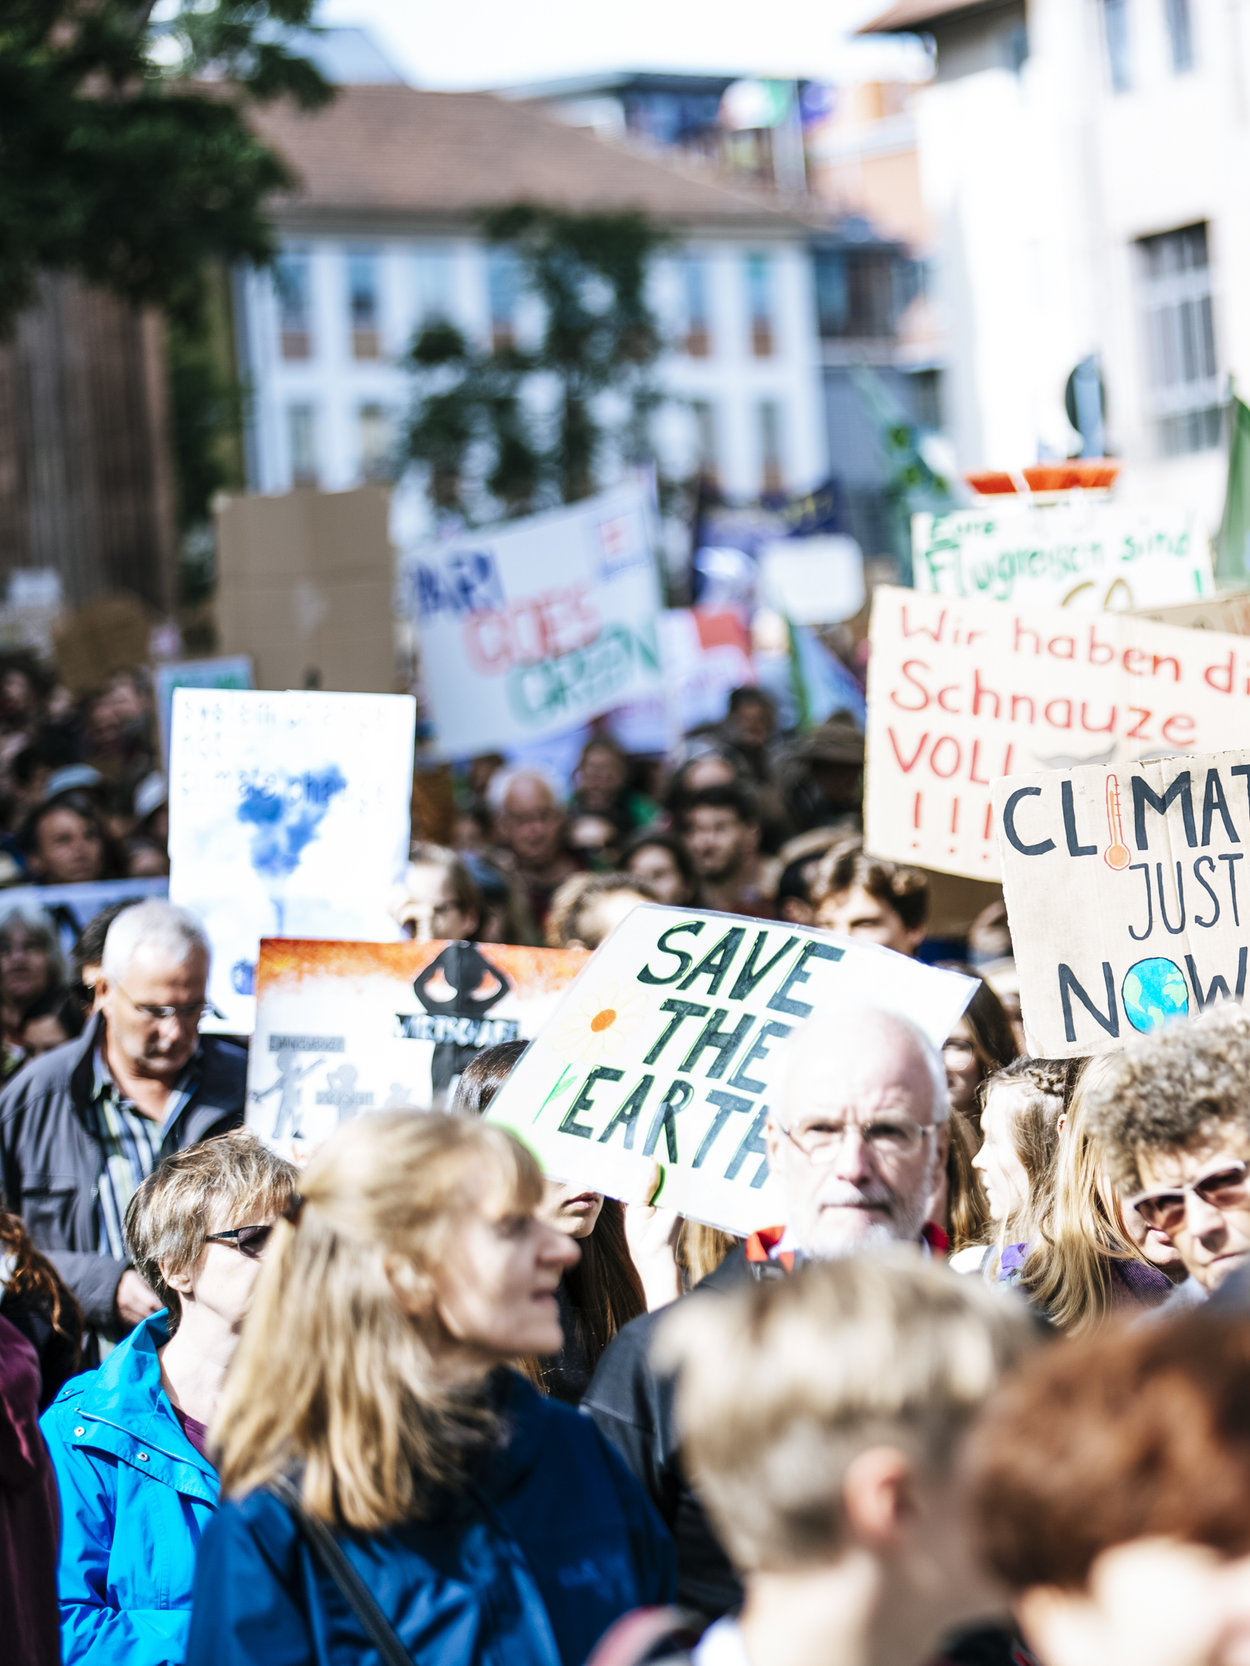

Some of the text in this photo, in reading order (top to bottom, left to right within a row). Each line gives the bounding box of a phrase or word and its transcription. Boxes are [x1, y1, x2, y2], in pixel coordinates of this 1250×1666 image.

[901, 604, 986, 646] Wir
[1013, 617, 1181, 683] haben
[890, 659, 1197, 748] Schnauze
[637, 920, 847, 1018] SAVE
[643, 998, 796, 1093] THE
[558, 1065, 771, 1190] EARTH
